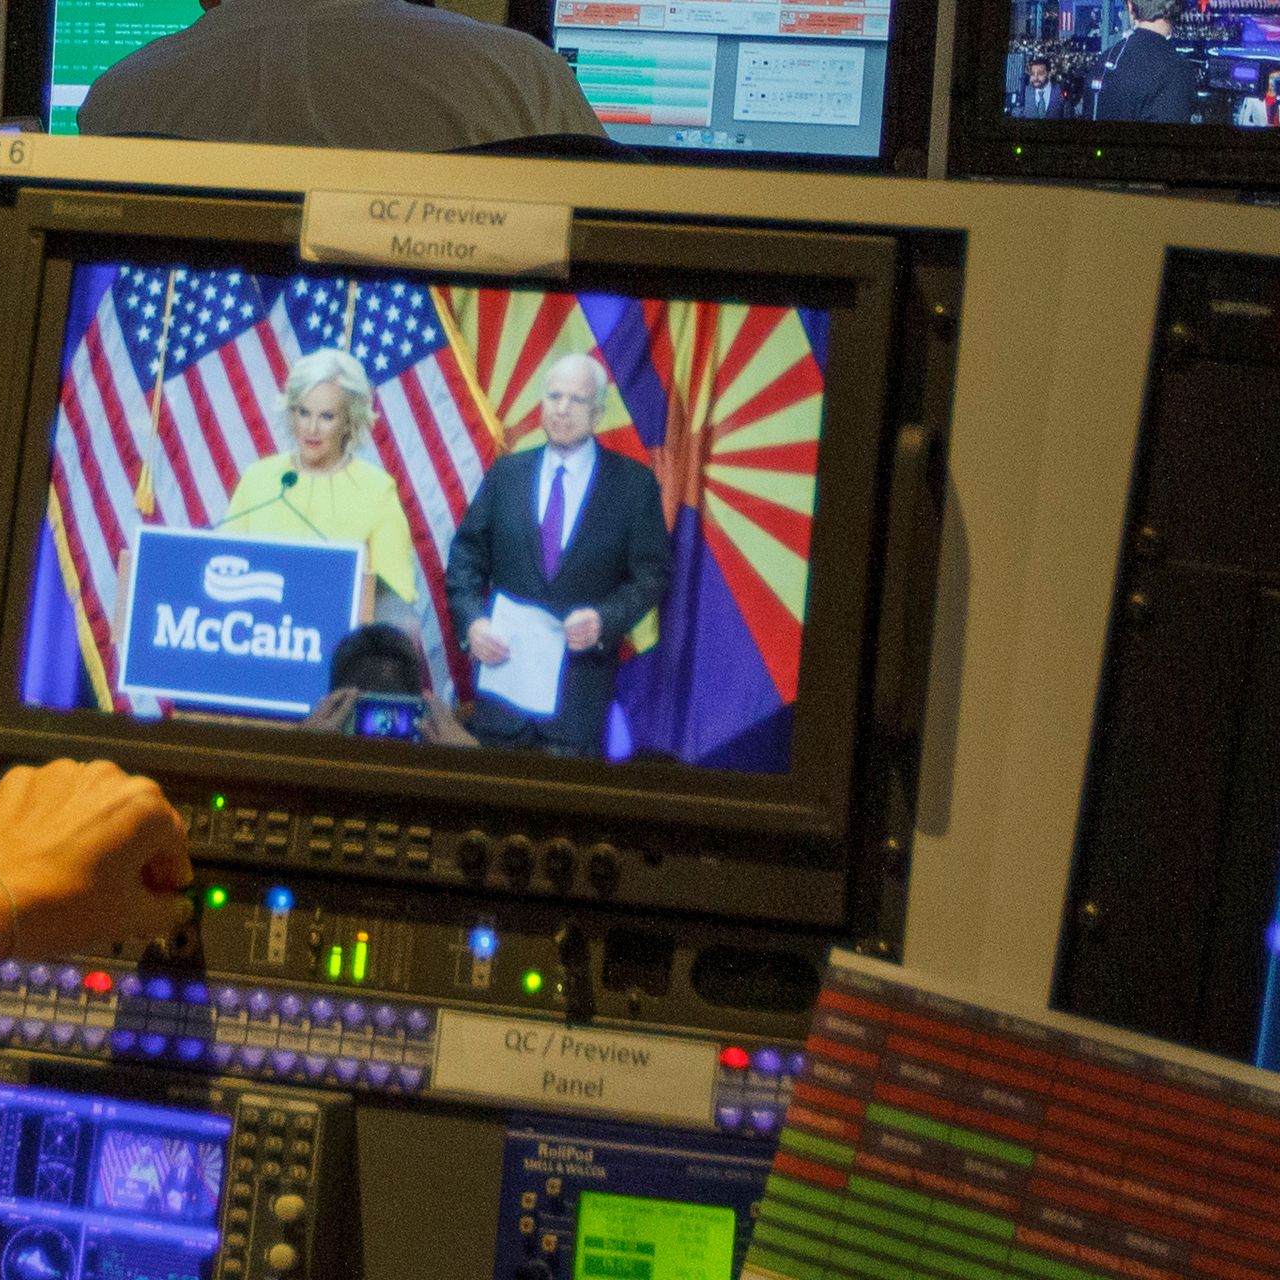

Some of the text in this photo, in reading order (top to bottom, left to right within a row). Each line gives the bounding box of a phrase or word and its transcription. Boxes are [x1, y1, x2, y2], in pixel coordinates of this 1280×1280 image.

[9, 139, 25, 164] 6
[369, 198, 508, 226] QC / Preview
[391, 235, 478, 258] Monitor
[153, 602, 323, 663] McCain
[504, 1029, 651, 1066] QC / Preview
[542, 1070, 604, 1098] Panel
[538, 1142, 594, 1162] RollPod
